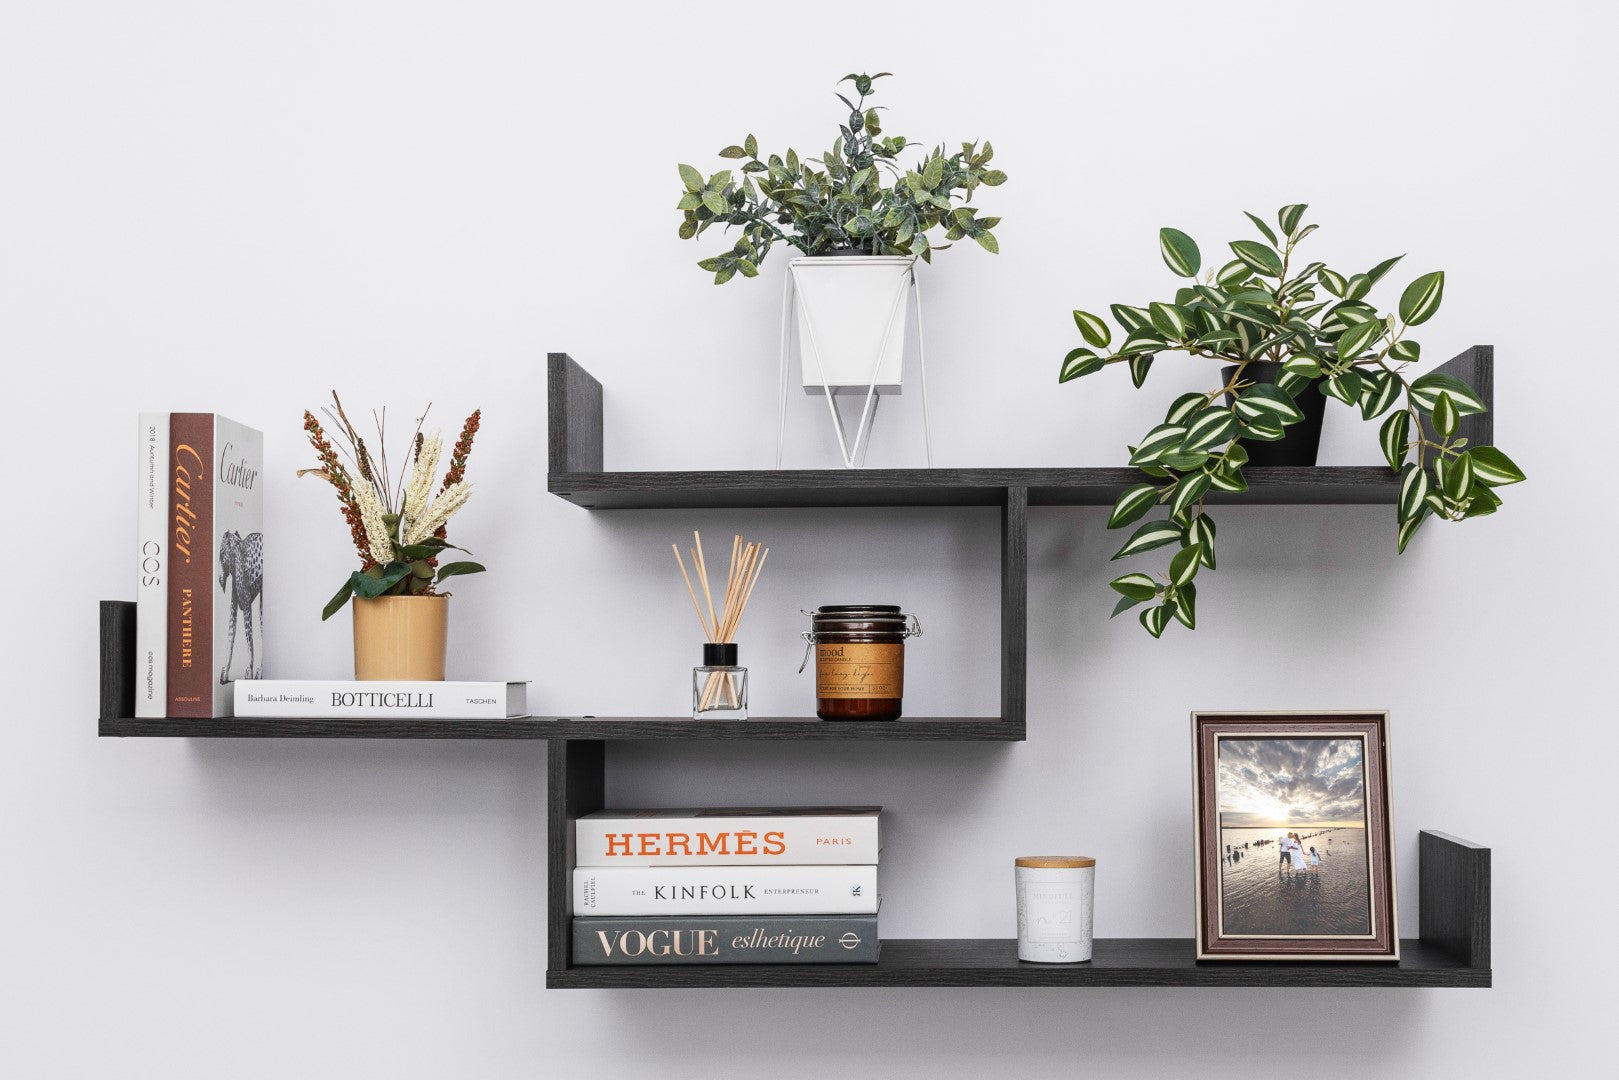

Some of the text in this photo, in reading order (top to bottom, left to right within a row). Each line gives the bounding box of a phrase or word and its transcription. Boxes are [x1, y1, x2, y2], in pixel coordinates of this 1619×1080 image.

[220, 441, 258, 490] Cartier
[176, 444, 203, 563] Cartier
[143, 540, 160, 587] COS
[183, 589, 192, 667] PANTHERE
[146, 664, 154, 700] magazine
[247, 693, 314, 704] Barbara Deimling
[331, 692, 434, 708] BOTTICELLI
[816, 837, 852, 846] PARIS
[654, 884, 756, 900] KINFOLK
[596, 930, 718, 956] VOGUE
